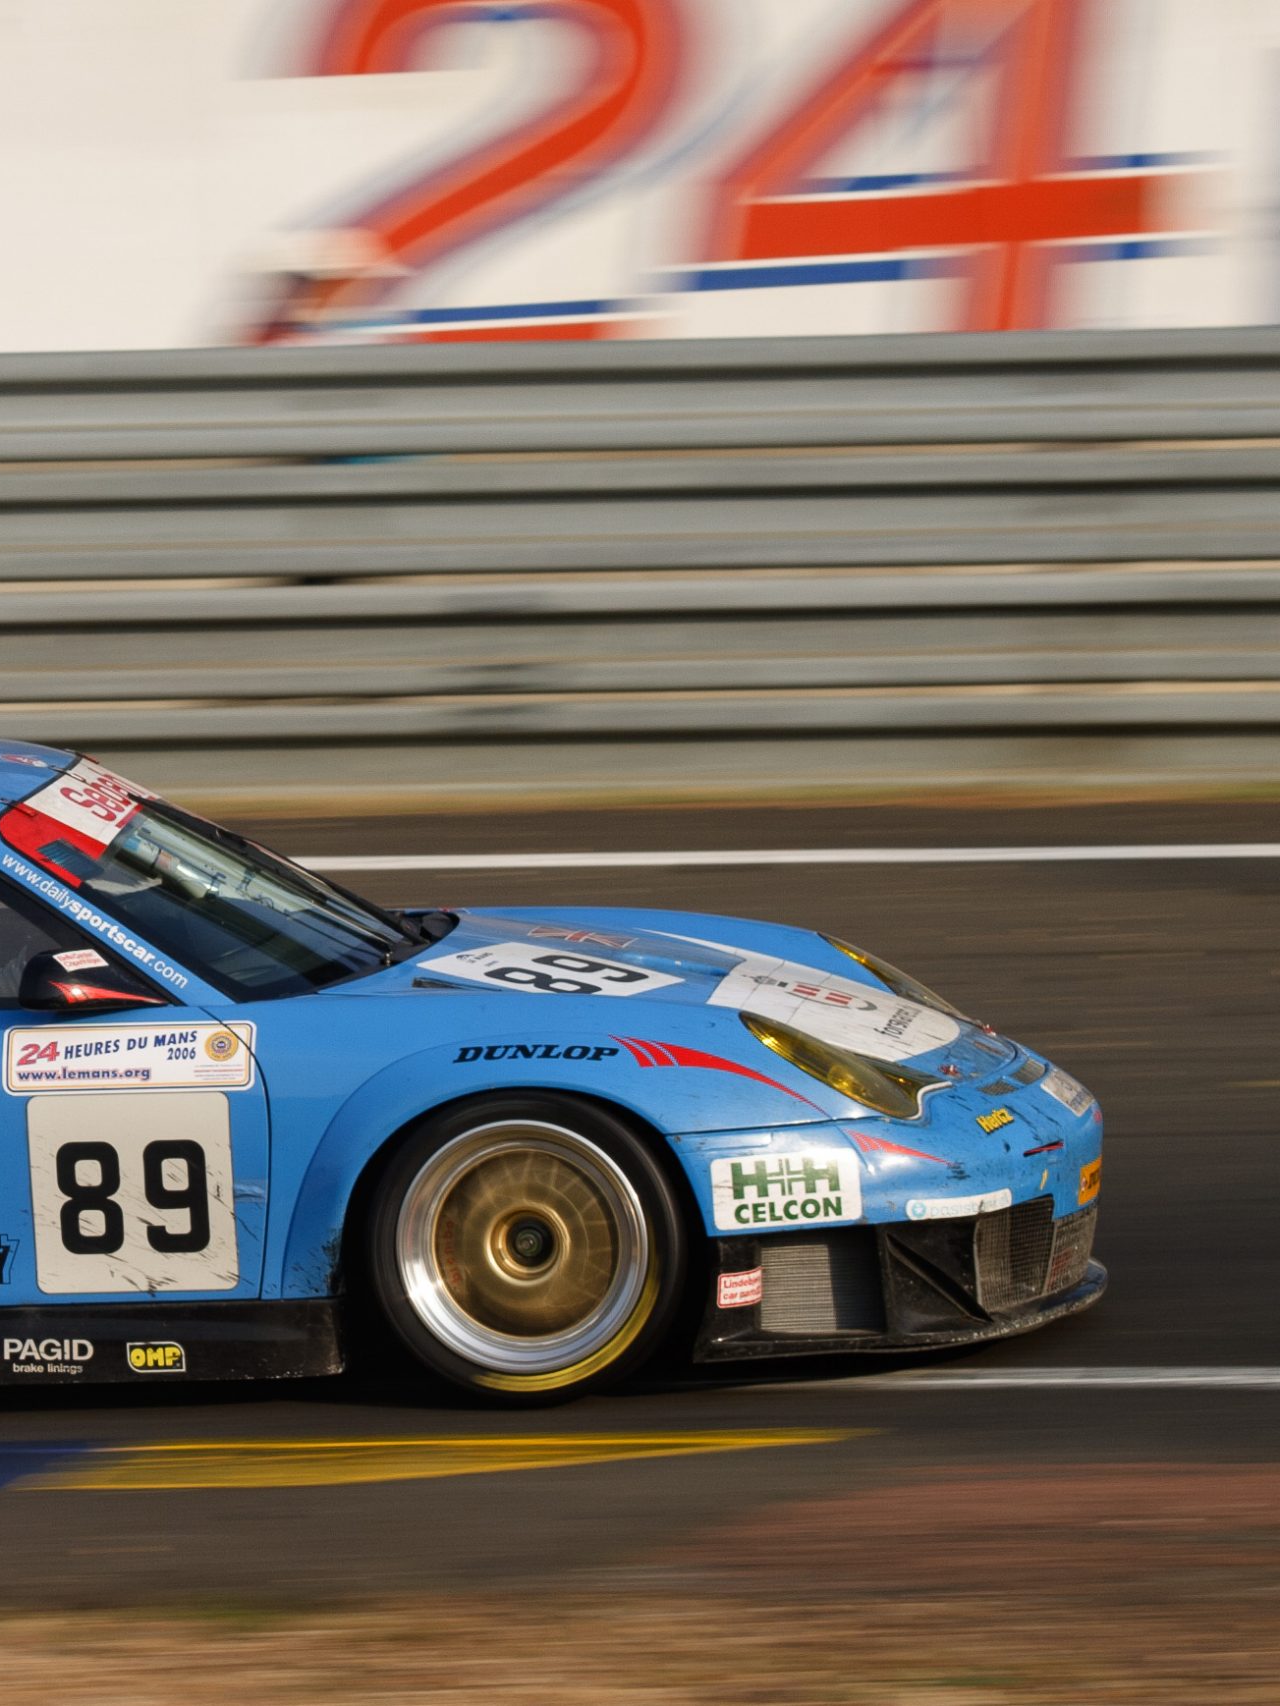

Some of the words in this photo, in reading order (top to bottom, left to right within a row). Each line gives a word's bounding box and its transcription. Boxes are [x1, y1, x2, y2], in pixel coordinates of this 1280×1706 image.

[1, 853, 189, 989] www.dailysportscar.com
[483, 953, 650, 995] 89
[16, 1041, 60, 1067] 24
[64, 1039, 120, 1060] HEURES
[126, 1036, 148, 1051] DU
[153, 1030, 198, 1048] MANS
[166, 1047, 197, 1061] 2006
[452, 1043, 620, 1065] DUNLOP
[17, 1065, 152, 1082] www.lemans.org
[55, 1139, 211, 1255] 89
[734, 1196, 843, 1225] CELCON
[3, 1338, 95, 1361] PAGID
[130, 1346, 182, 1367] OMP
[12, 1362, 45, 1374] brake
[46, 1362, 84, 1376] linings
